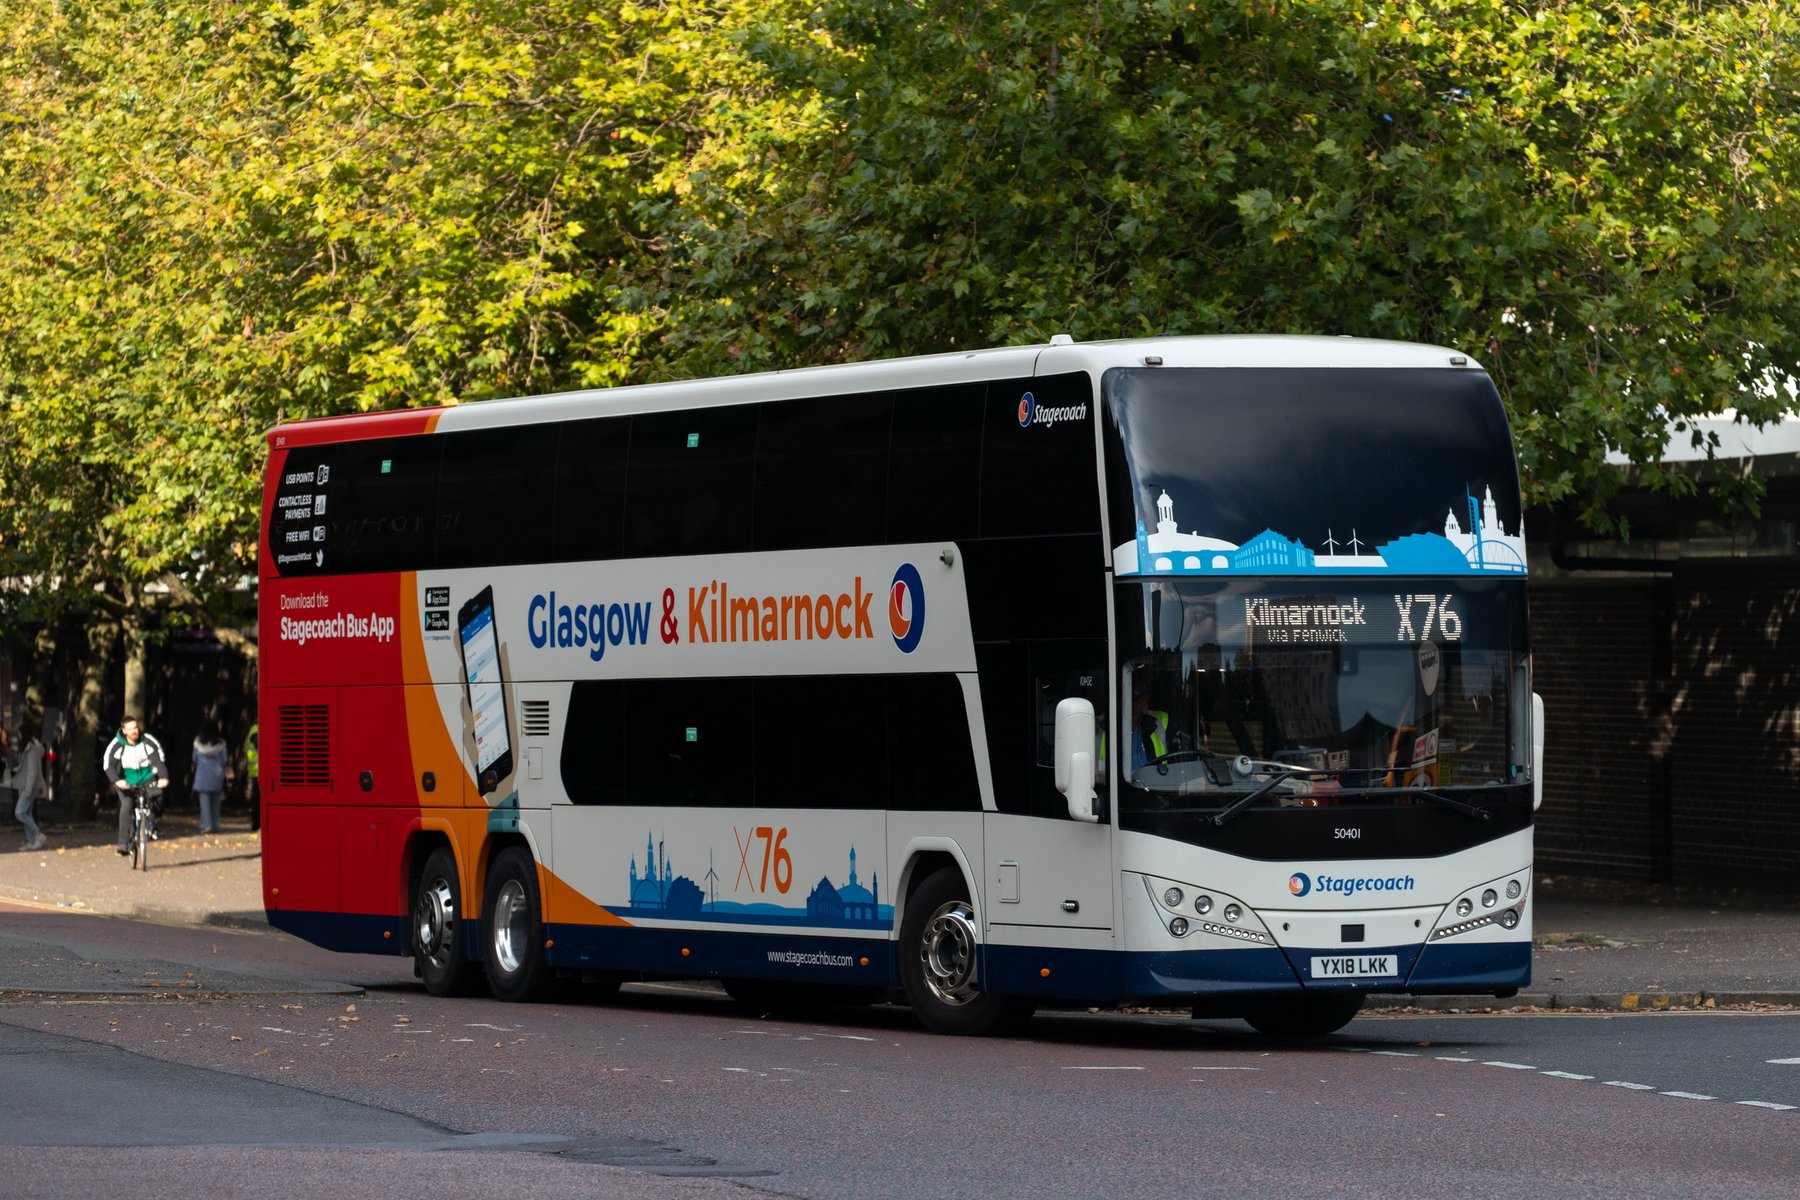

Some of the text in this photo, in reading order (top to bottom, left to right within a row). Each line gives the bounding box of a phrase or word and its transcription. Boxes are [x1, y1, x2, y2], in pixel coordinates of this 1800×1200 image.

[1033, 402, 1086, 428] Stagecoach
[285, 471, 314, 485] USB POINTS
[278, 494, 312, 508] CONTACTLESS
[285, 507, 311, 520] PAYMENTS
[285, 531, 298, 543] FREE
[280, 591, 329, 610] Download the
[528, 576, 874, 662] Glasgow & Kilmarnock
[1245, 594, 1462, 641] Kilmarnock X76
[280, 612, 394, 646] Stagecoach Bus App
[1334, 828, 1361, 839] 50401
[733, 826, 793, 895] X76
[1316, 875, 1415, 896] Stagecoach
[767, 950, 854, 967] www.stagecoachbus.com
[1321, 957, 1388, 975] YX18 LKK
